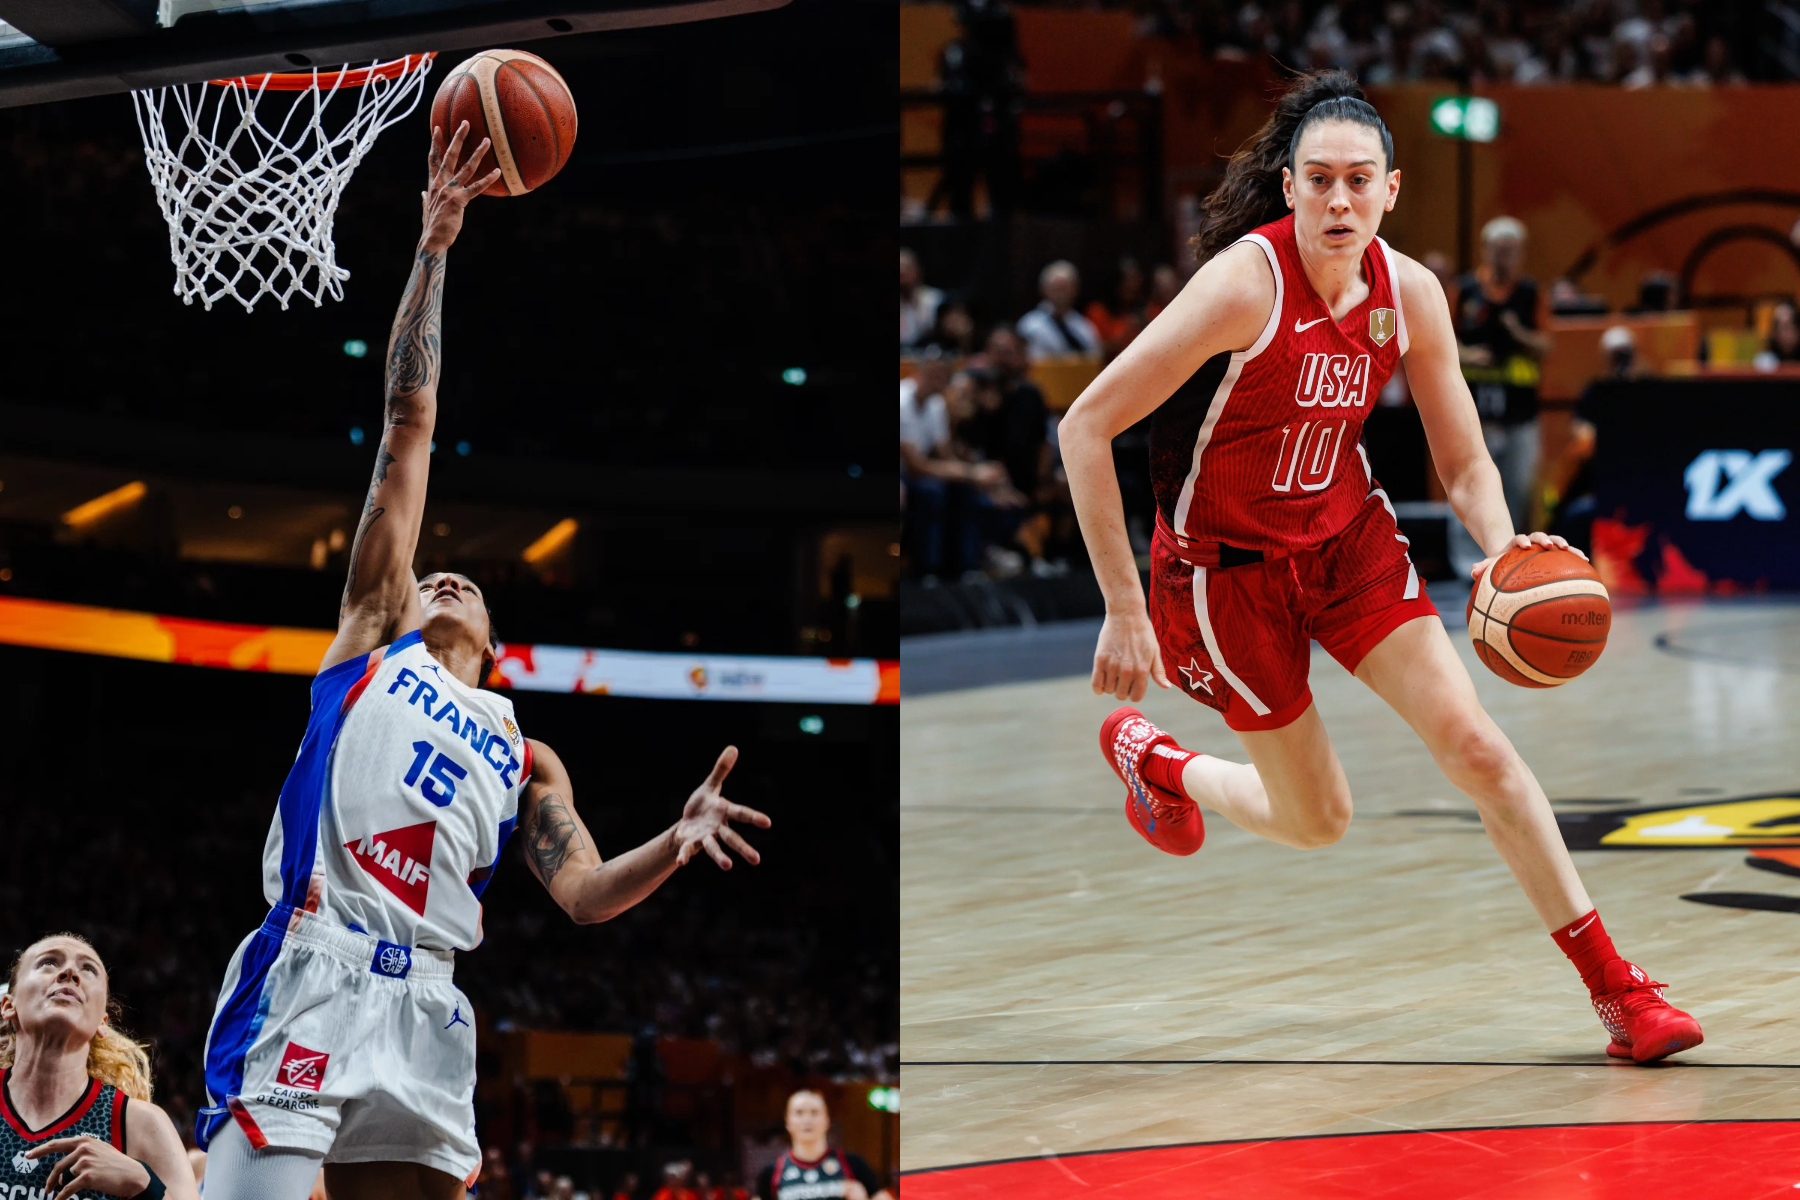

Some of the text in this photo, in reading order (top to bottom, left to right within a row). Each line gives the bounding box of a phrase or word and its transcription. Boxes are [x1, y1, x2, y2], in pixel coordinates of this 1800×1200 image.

[1295, 353, 1370, 407] USA
[1272, 419, 1347, 492] 10
[1684, 449, 1792, 521] 1X
[1561, 611, 1607, 626] molten
[1566, 650, 1594, 663] FIBA
[387, 667, 520, 790] FRANCE
[403, 740, 468, 807] 15
[355, 834, 430, 886] MAIF
